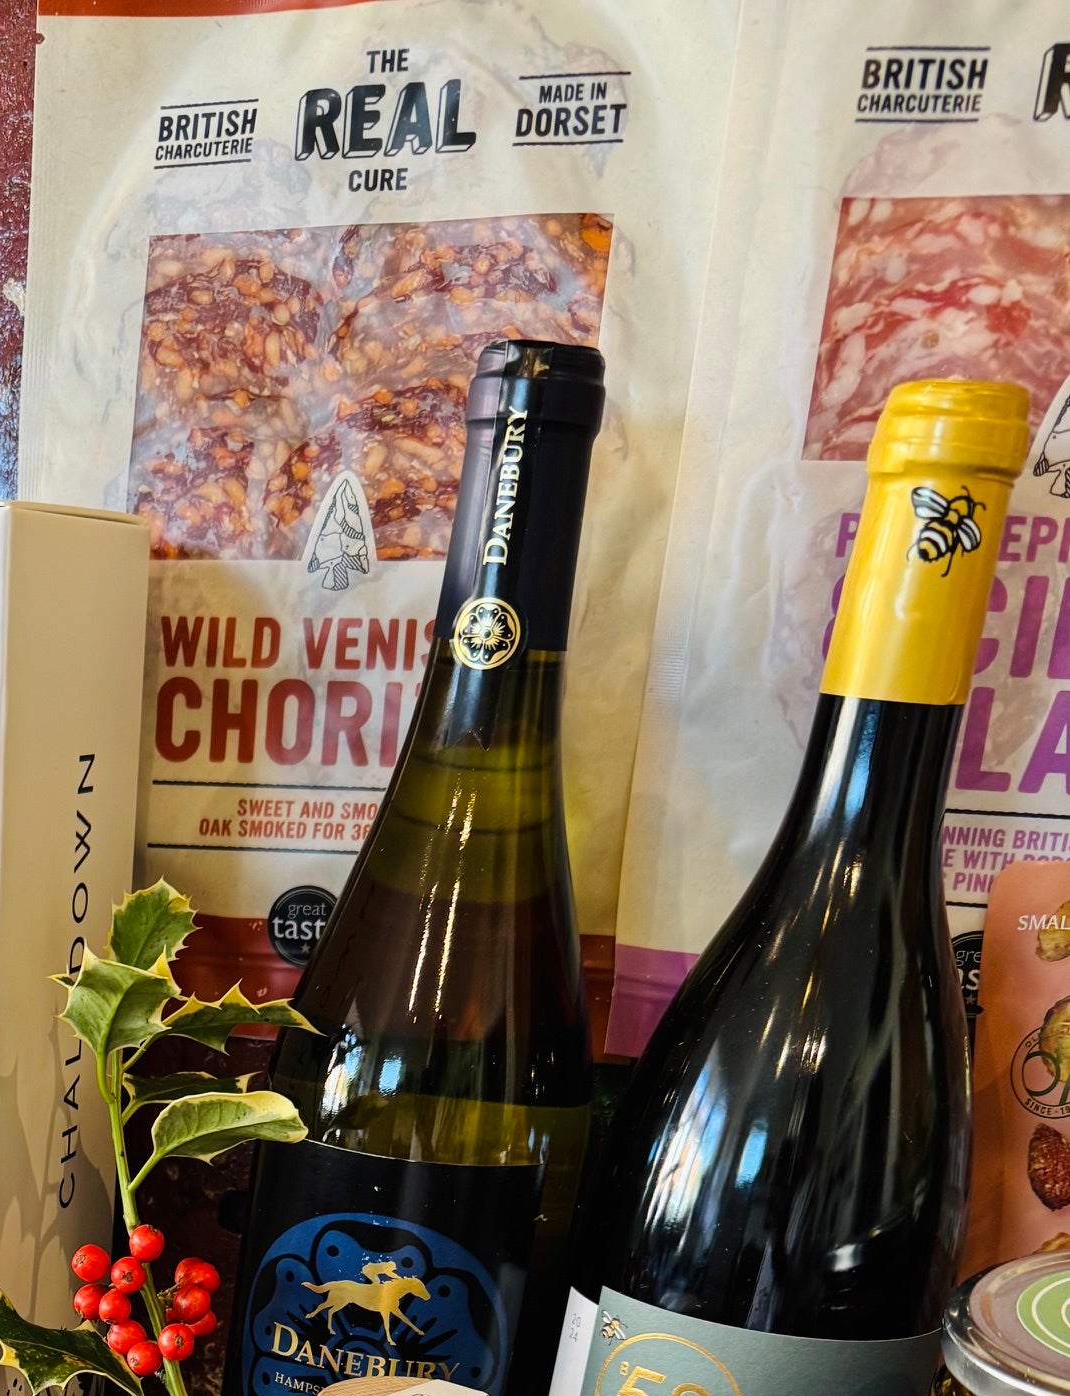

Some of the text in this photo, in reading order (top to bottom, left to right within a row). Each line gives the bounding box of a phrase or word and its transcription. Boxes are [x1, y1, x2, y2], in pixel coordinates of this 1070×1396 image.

[366, 48, 410, 74] THE
[861, 58, 988, 90] BRITISH
[538, 81, 608, 104] MADE IN
[856, 93, 983, 114] CHARCUTERIE
[158, 108, 257, 143] BRITISH
[294, 79, 476, 161] REAL
[515, 103, 628, 138] DORSET
[155, 137, 254, 161] CHARCUTERIE
[347, 167, 409, 193] CURE
[482, 406, 529, 566] DANEBURY
[160, 616, 436, 671] WILD VENI
[155, 677, 410, 768] CHORI
[237, 798, 377, 821] SWEET AND SMO
[199, 818, 346, 840] OAK SMOKED FOR
[287, 901, 327, 919] great
[272, 916, 326, 941] tast
